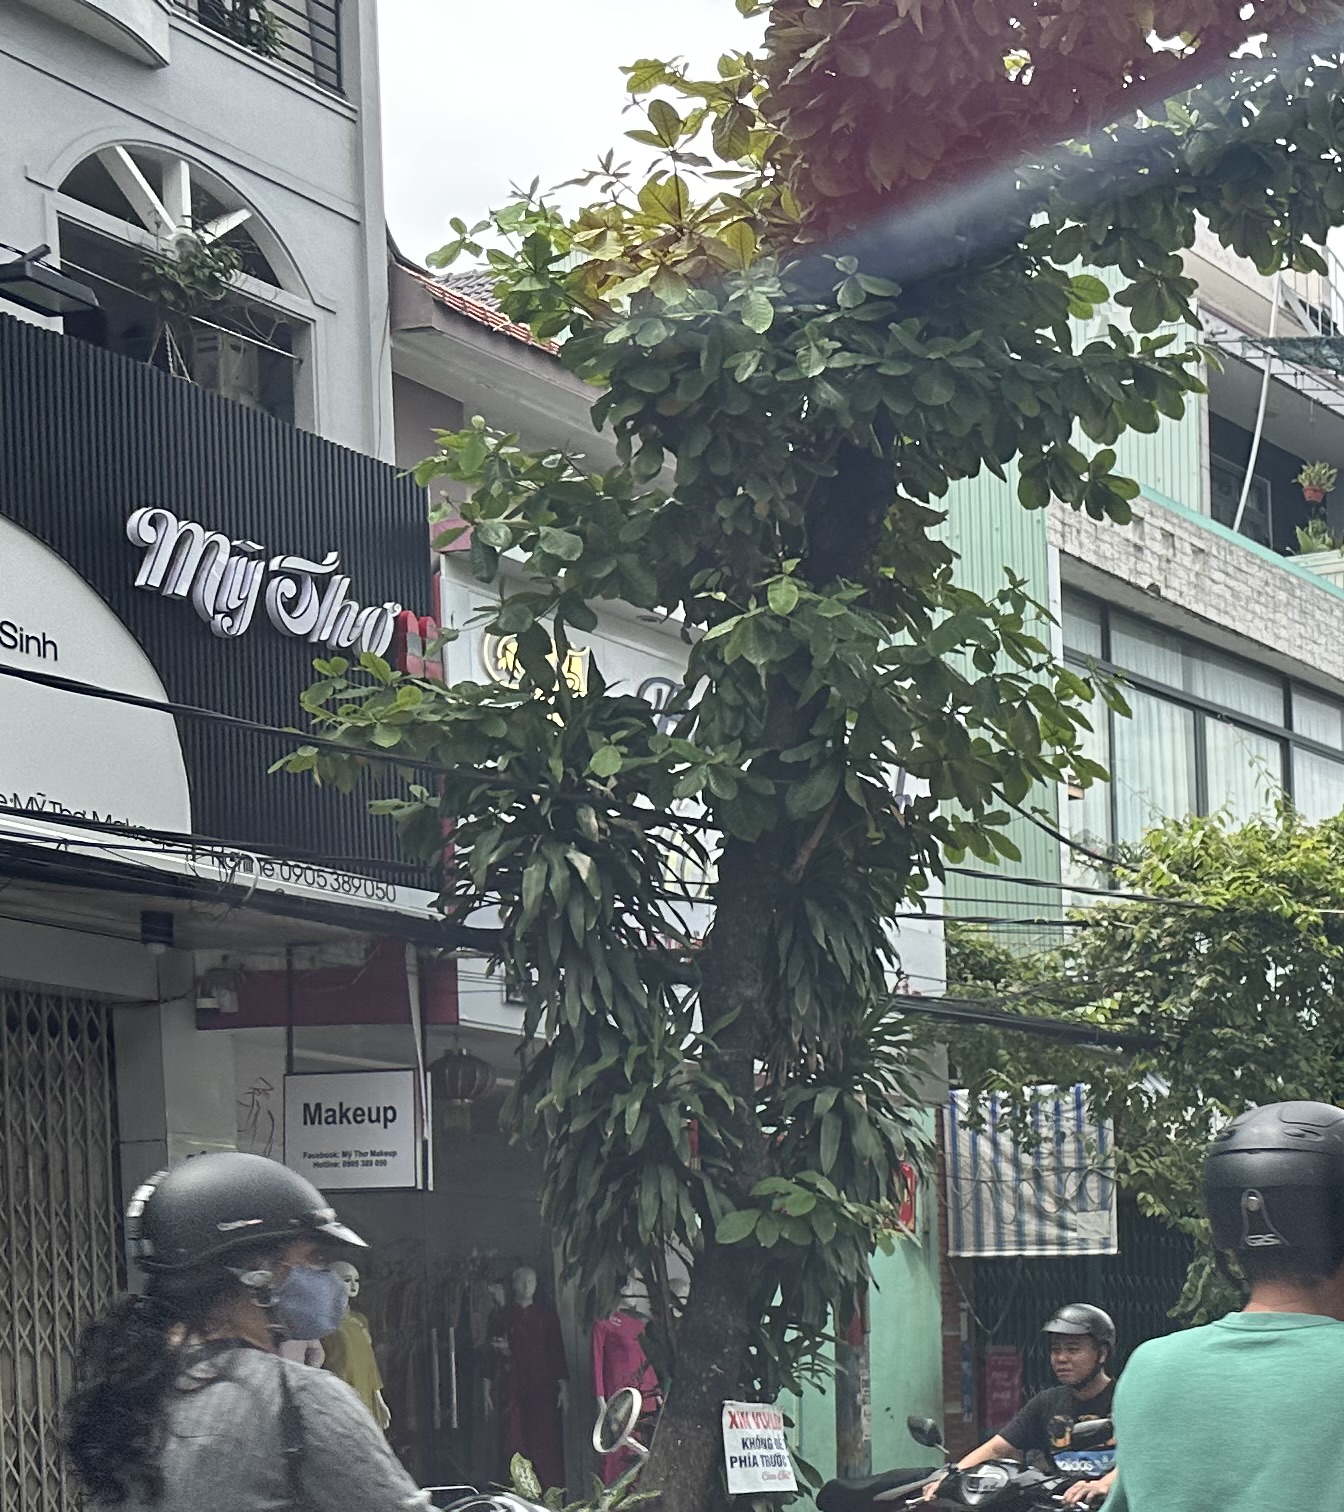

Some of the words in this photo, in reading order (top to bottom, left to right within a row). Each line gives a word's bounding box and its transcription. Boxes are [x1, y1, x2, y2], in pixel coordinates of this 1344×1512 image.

[127, 507, 265, 639] Mỹ
[265, 552, 402, 660] Thơ
[0, 621, 58, 661] Sinh
[303, 1102, 397, 1129] Makeup
[303, 1151, 339, 1159] Facebook:
[370, 1150, 397, 1158] Makeup
[742, 1434, 773, 1450] KHÔNG
[730, 1452, 759, 1468] PHÍA
